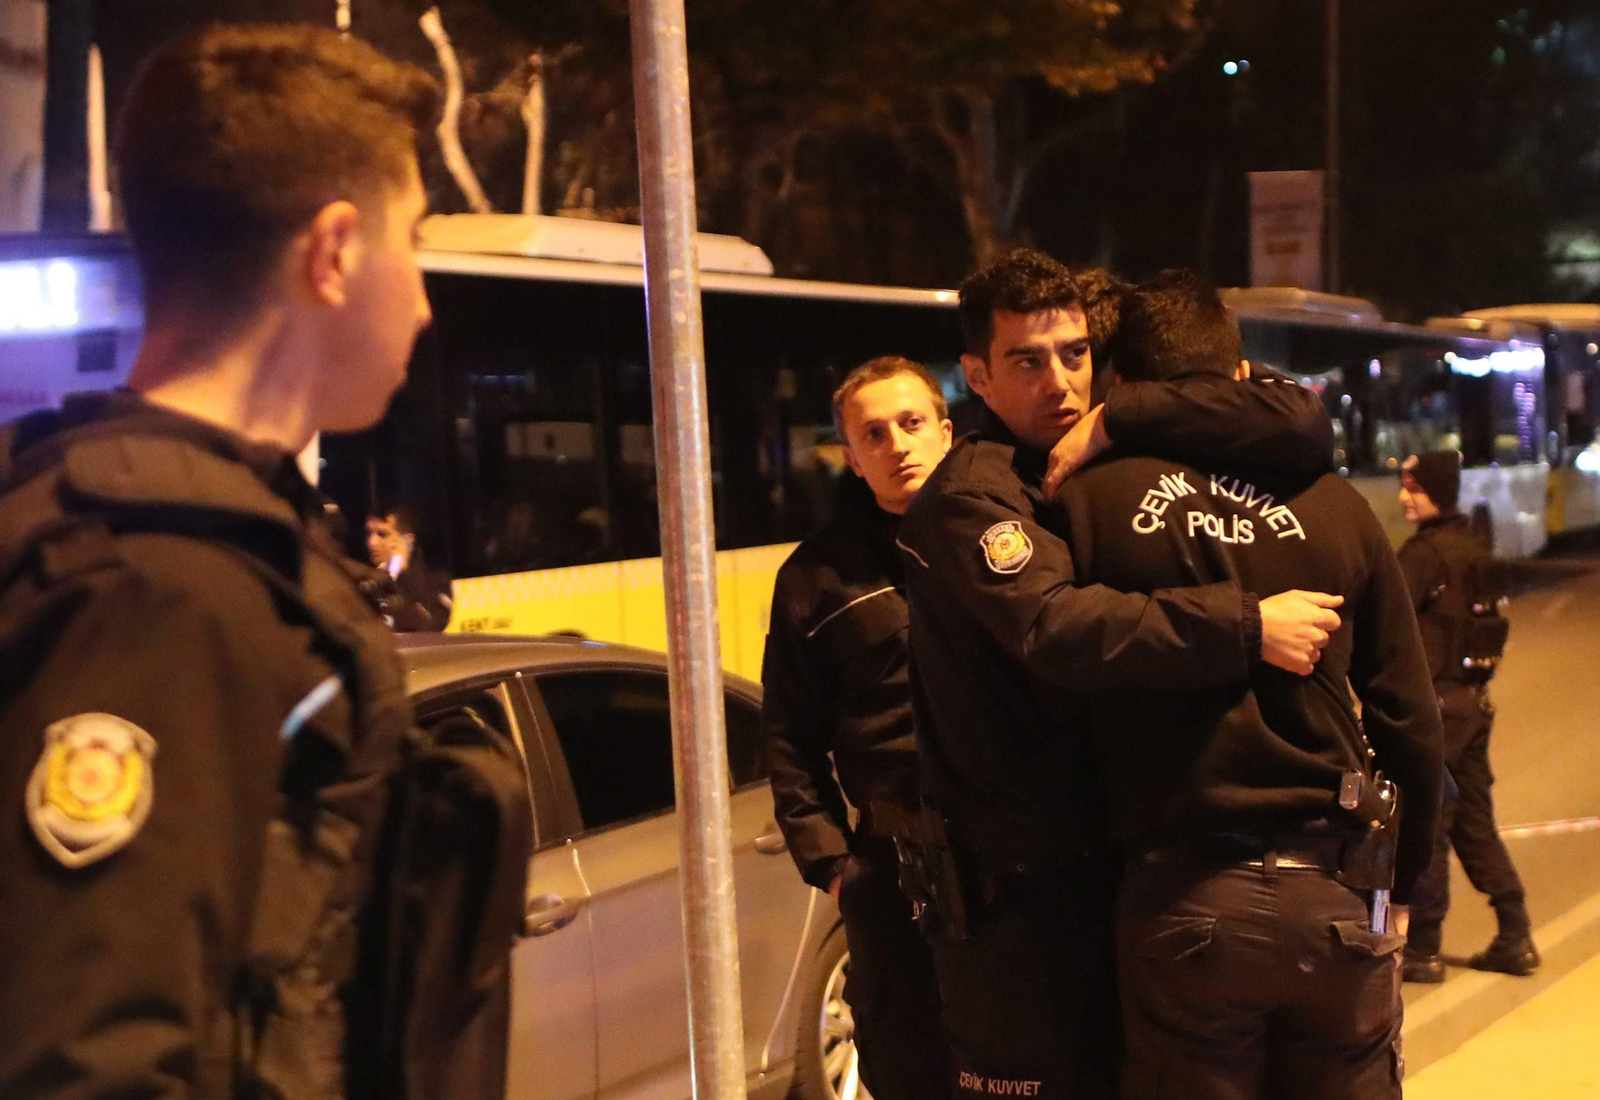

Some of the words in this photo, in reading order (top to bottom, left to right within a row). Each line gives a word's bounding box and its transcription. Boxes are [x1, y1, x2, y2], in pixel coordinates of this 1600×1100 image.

[1131, 471, 1198, 535] ÇEVİK
[1209, 473, 1307, 541] KUVVET
[1186, 510, 1256, 544] POLİS
[987, 1077, 1042, 1096] KUVVET
